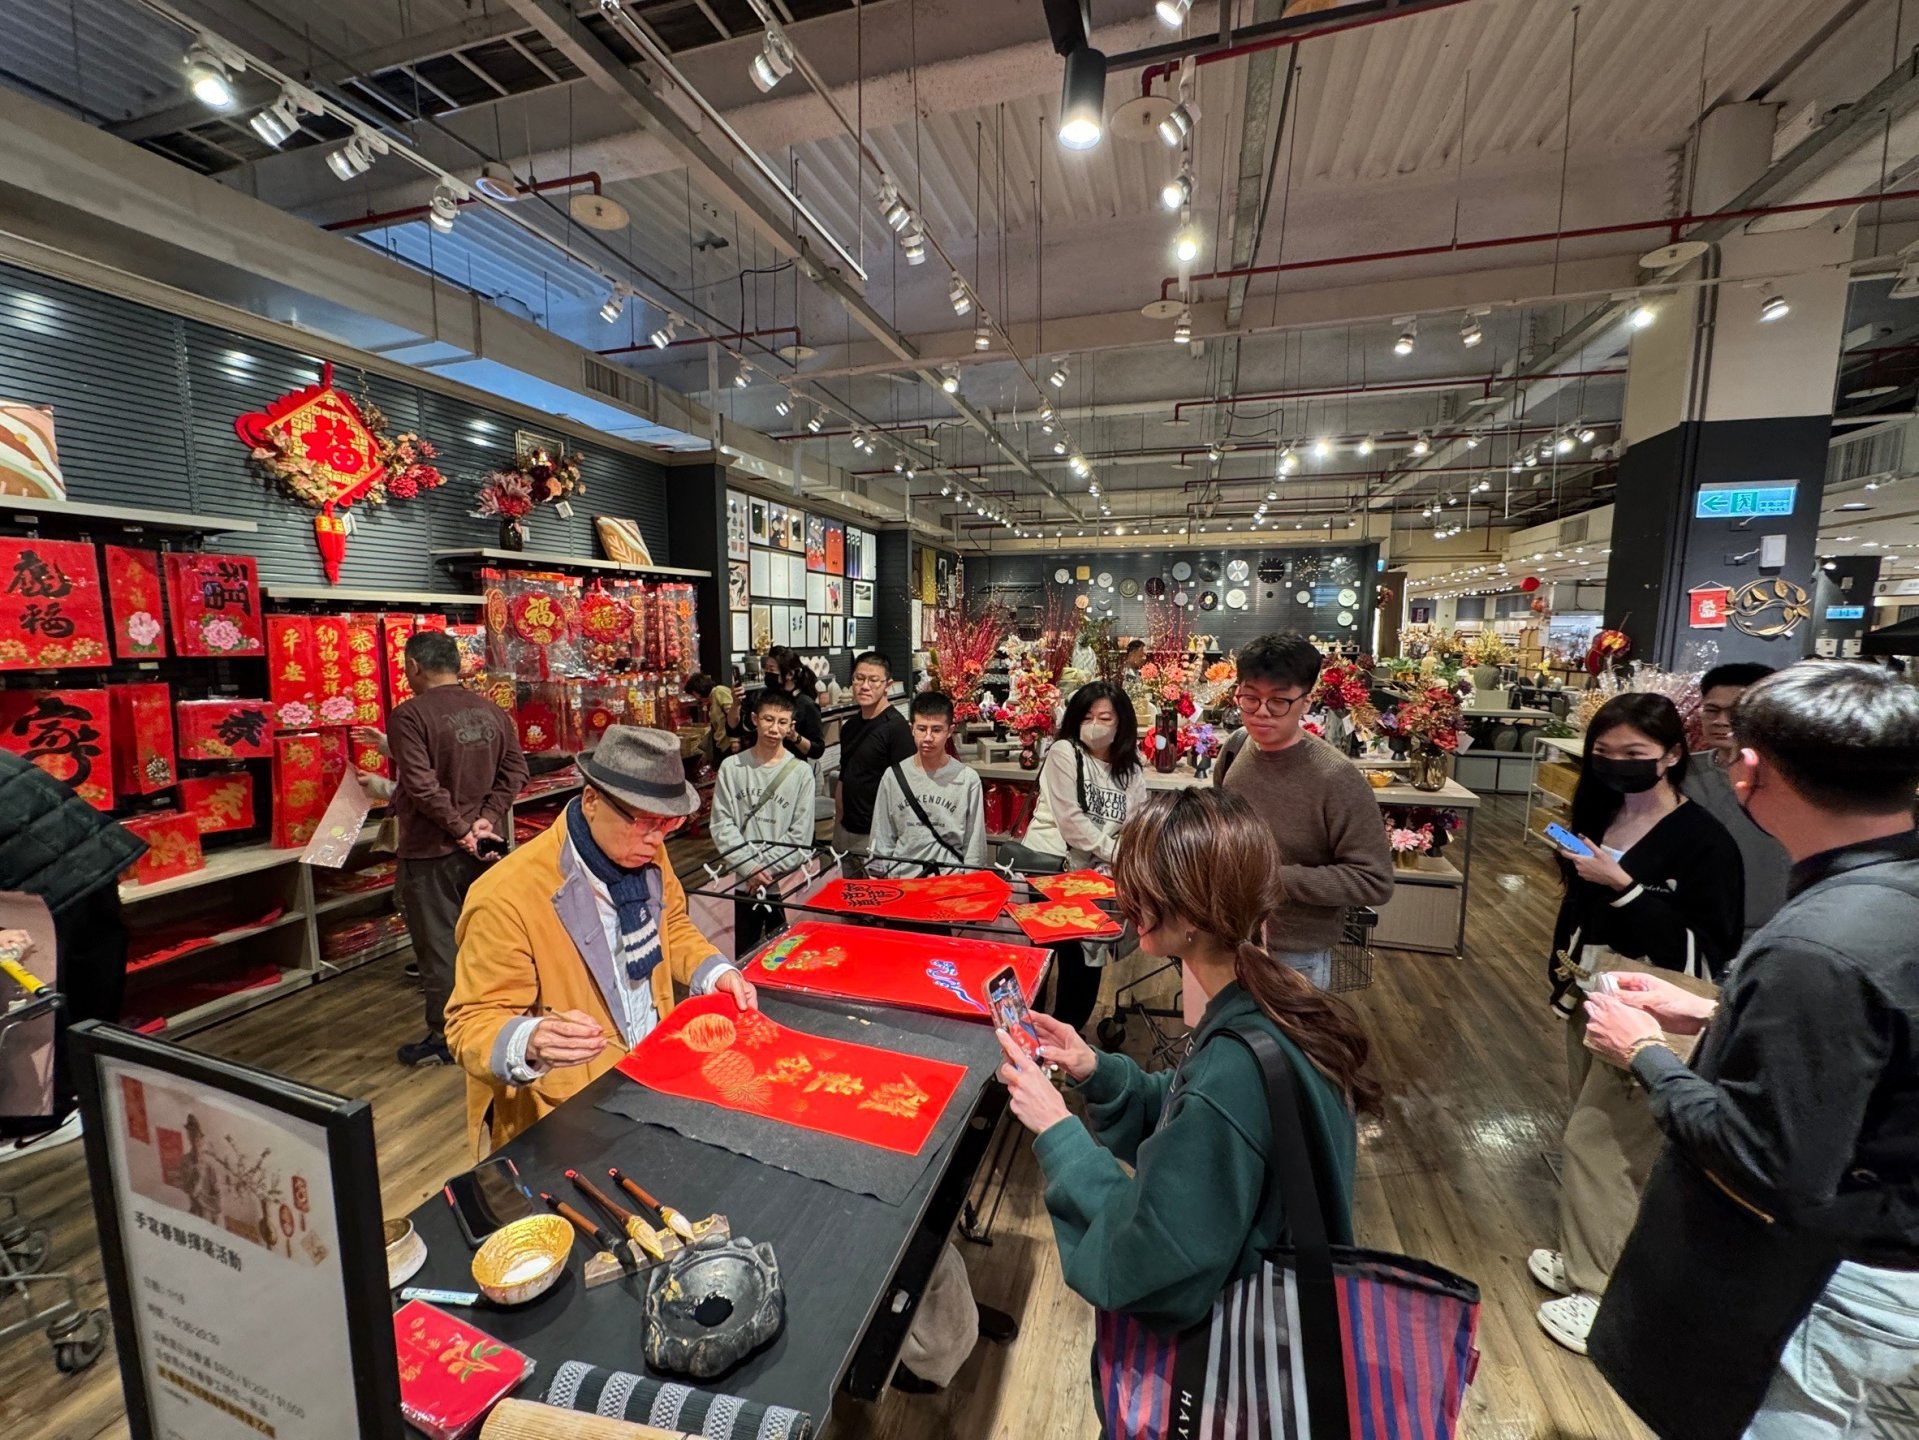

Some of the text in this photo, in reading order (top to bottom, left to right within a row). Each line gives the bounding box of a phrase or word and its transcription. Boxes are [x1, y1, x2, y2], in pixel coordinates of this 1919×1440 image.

[301, 414, 364, 474] 福
[525, 597, 556, 627] 福
[280, 628, 306, 682] 平安
[351, 631, 380, 723] 恭喜發財
[898, 794, 957, 813] WEKENDING
[134, 1210, 242, 1272] 手寫春聯揮毫活動
